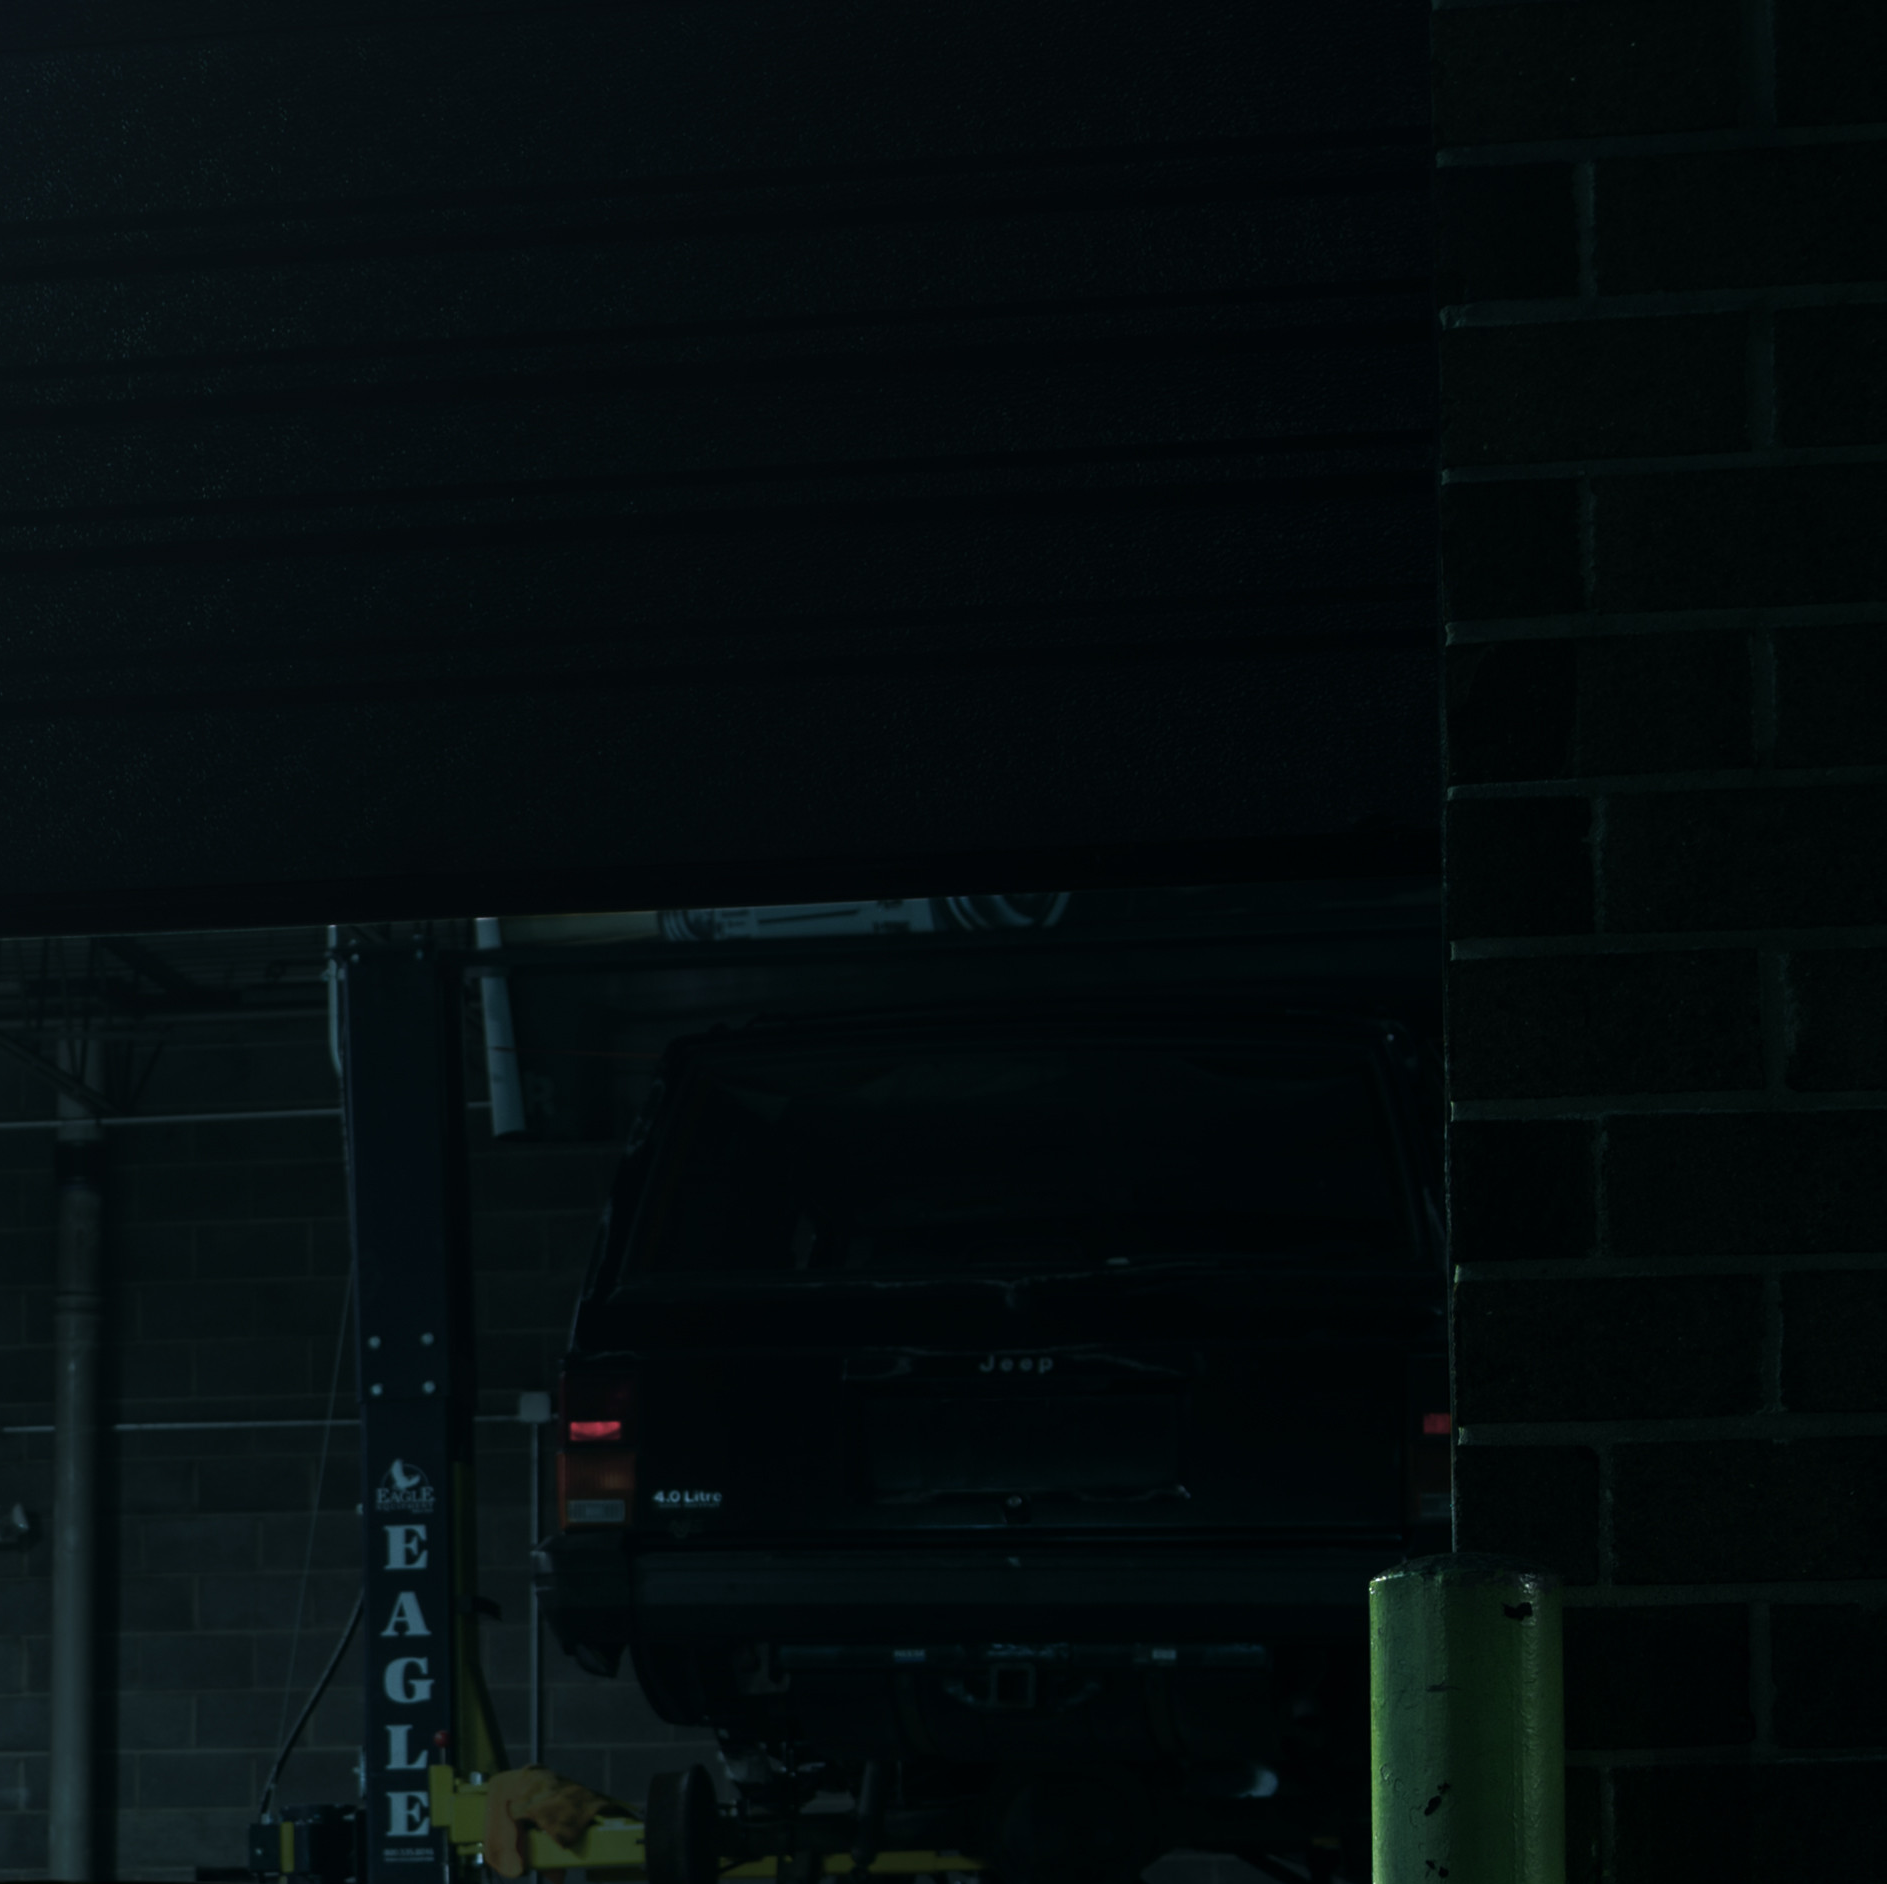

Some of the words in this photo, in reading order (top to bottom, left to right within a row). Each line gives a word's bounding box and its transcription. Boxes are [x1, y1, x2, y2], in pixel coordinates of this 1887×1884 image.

[977, 1352, 1055, 1377] Jeep
[376, 1485, 436, 1503] EAGLE
[652, 1488, 681, 1503] 4.0
[683, 1488, 723, 1503] Litre
[379, 1523, 436, 1838] EAGLE
